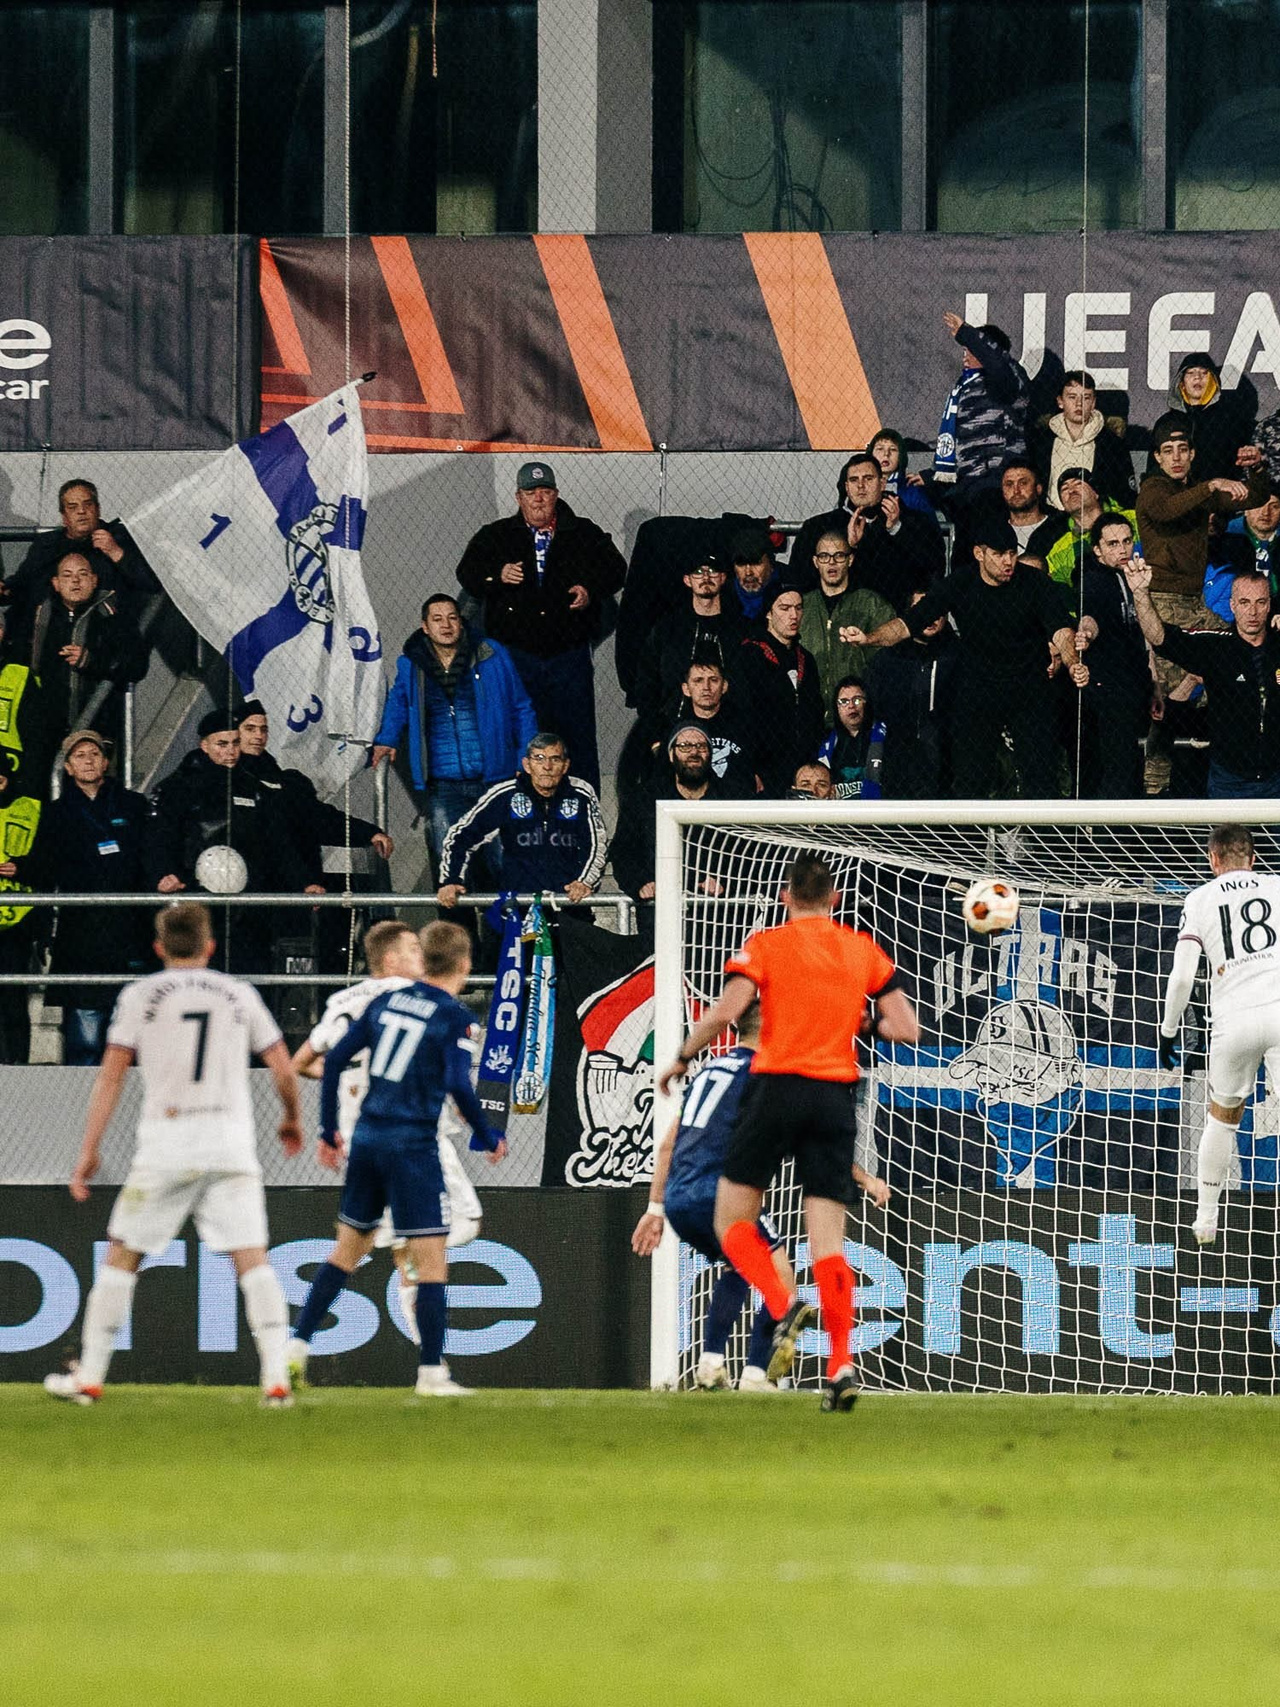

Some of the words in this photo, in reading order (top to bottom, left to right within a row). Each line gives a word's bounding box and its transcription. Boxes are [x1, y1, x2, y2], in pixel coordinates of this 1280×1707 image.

[1218, 898, 1277, 961] 18
[494, 936, 522, 1032] TSC
[933, 932, 1118, 1022] ULTRAS
[182, 1011, 212, 1083] 7
[370, 1010, 427, 1084] 17
[479, 1098, 507, 1112] TSC
[681, 1069, 735, 1129] 17
